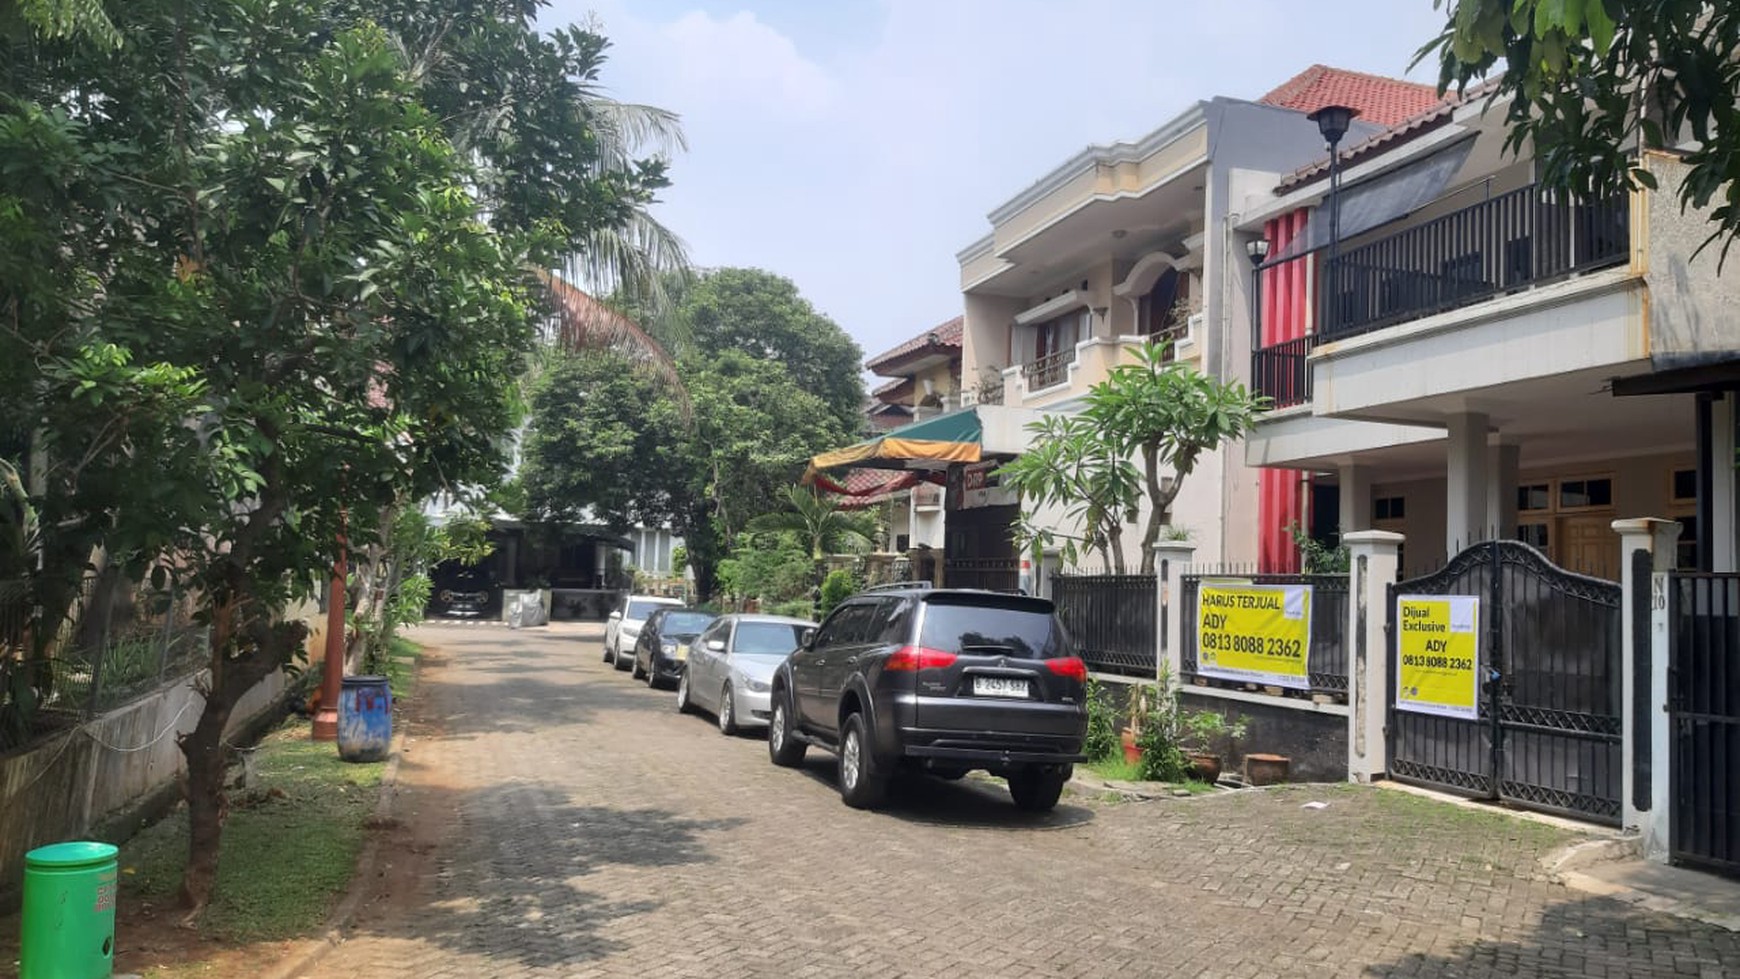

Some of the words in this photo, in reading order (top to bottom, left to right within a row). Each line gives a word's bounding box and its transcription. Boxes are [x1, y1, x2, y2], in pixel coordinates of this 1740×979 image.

[1654, 577, 1664, 593] N
[1202, 594, 1235, 608] HARUS
[1237, 596, 1280, 610] TERJUAL
[1403, 606, 1430, 619] Dijual
[1202, 613, 1227, 629] ADY
[1403, 620, 1445, 633] Exclusive
[1202, 633, 1231, 650] 0813
[1233, 636, 1264, 654] 8088
[1267, 639, 1301, 658] 2362
[1426, 640, 1447, 653] ADY
[1403, 654, 1425, 667] 0813
[1426, 656, 1448, 669] 8088
[1450, 658, 1472, 670] 2362
